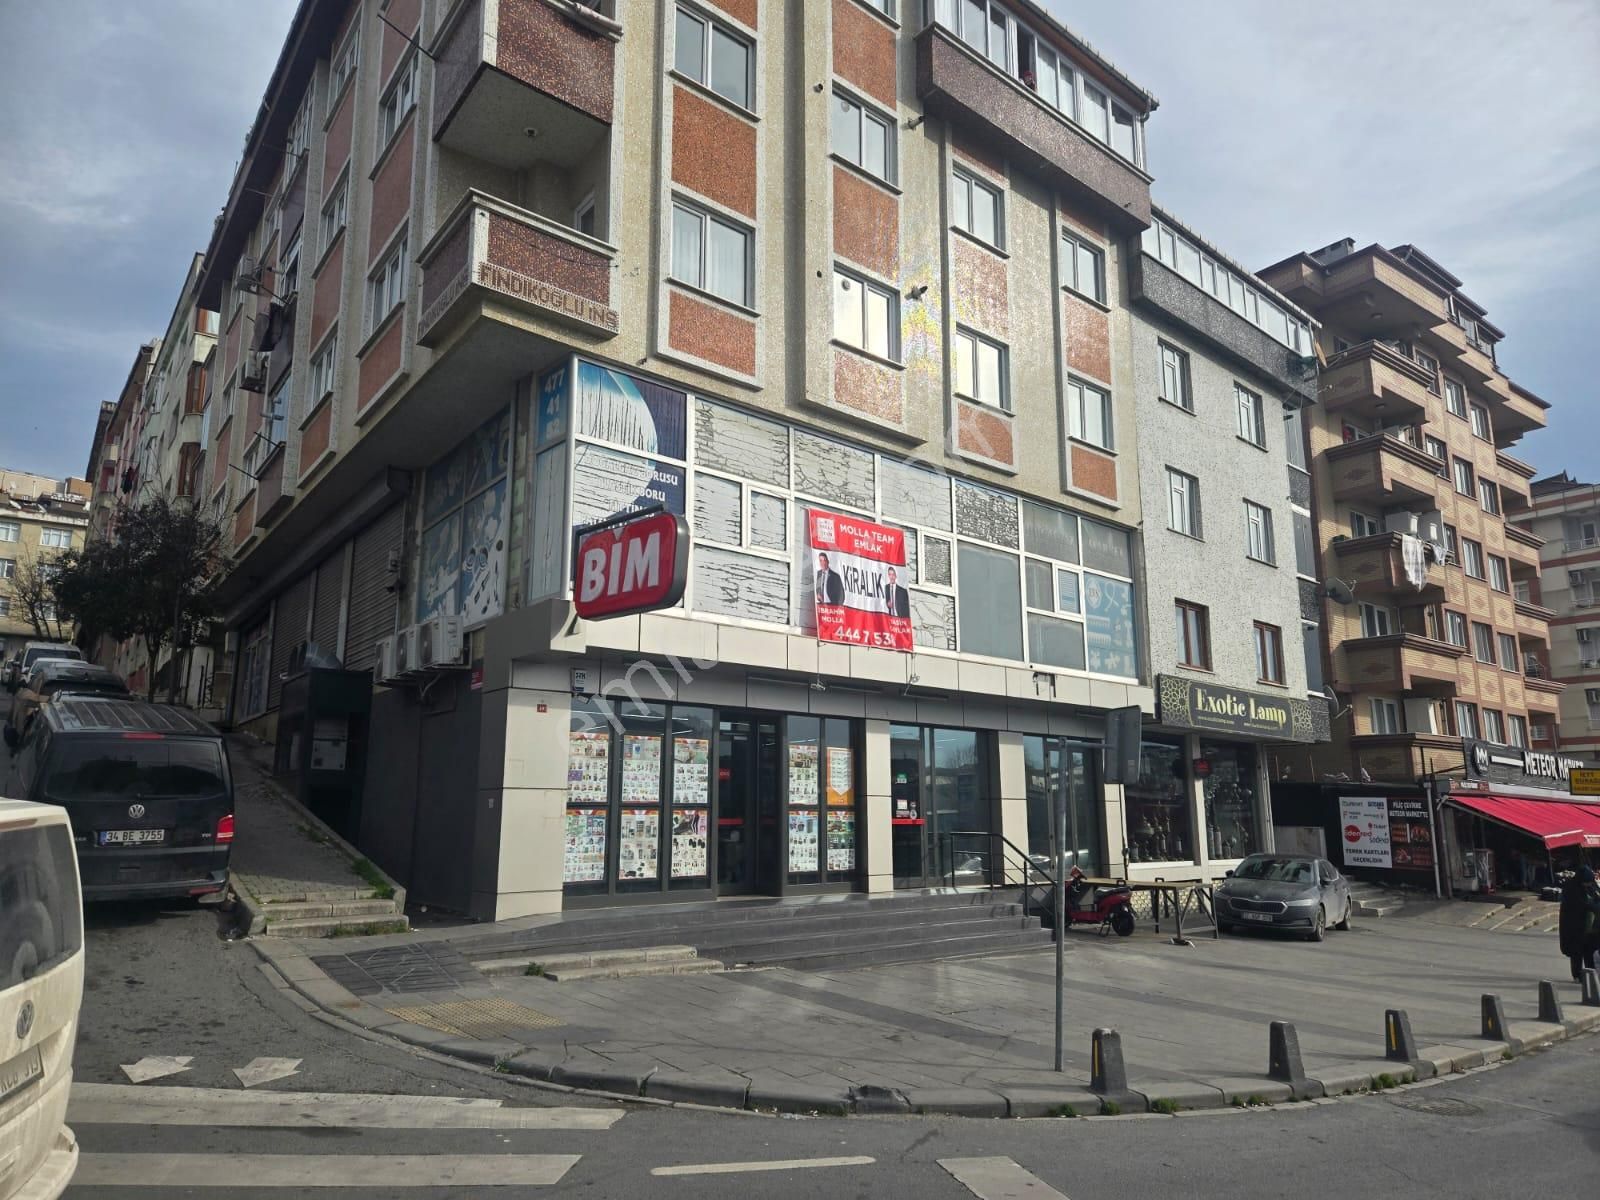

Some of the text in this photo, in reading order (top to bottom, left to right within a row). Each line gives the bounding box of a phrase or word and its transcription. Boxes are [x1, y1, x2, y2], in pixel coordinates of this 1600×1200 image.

[840, 524, 870, 539] MOLLA
[872, 531, 895, 545] TEAM
[854, 540, 883, 553] EMLAK
[1195, 687, 1287, 730] Exotic Lamp
[1524, 751, 1559, 780] METEOR
[107, 829, 162, 842] 34 BE 3755
